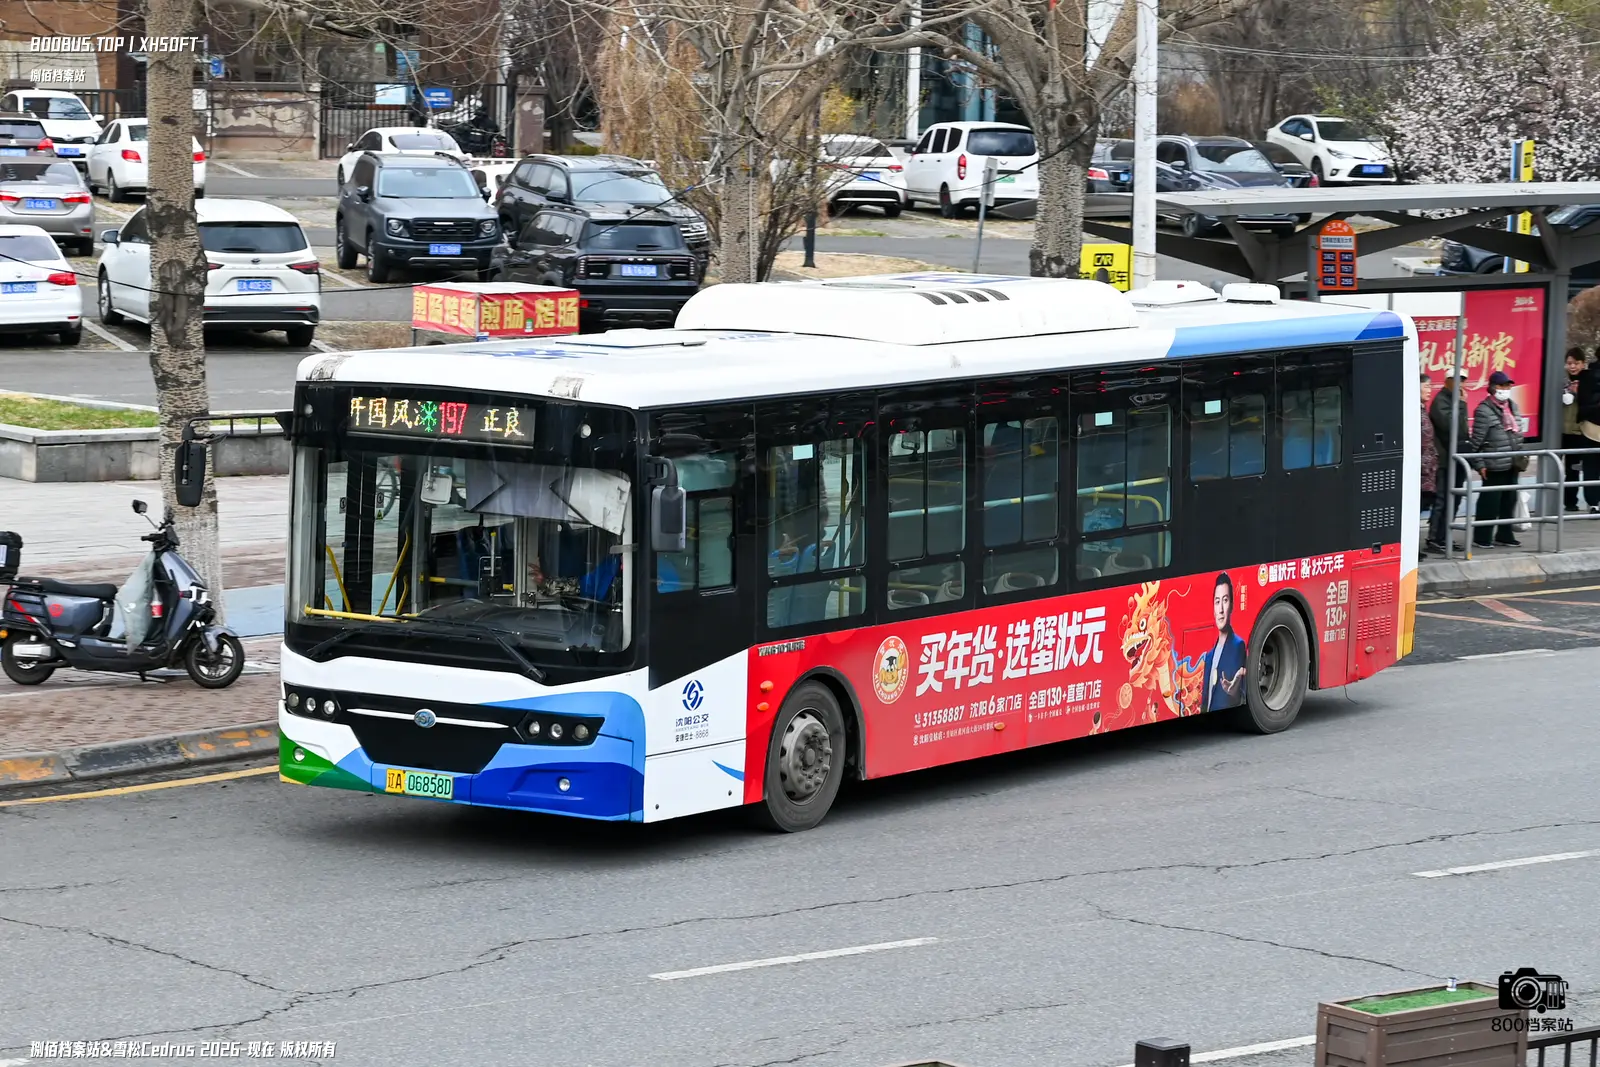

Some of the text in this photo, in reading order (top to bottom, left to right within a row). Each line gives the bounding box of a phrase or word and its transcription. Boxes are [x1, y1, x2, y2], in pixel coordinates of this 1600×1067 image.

[439, 402, 468, 434] 197
[480, 406, 525, 438] 正良
[1326, 580, 1348, 606] 全国
[1325, 606, 1347, 627] 130+
[675, 713, 709, 728] 沈阳公交
[921, 705, 965, 728] 31358887
[969, 693, 1023, 719] 沈阳6家门店
